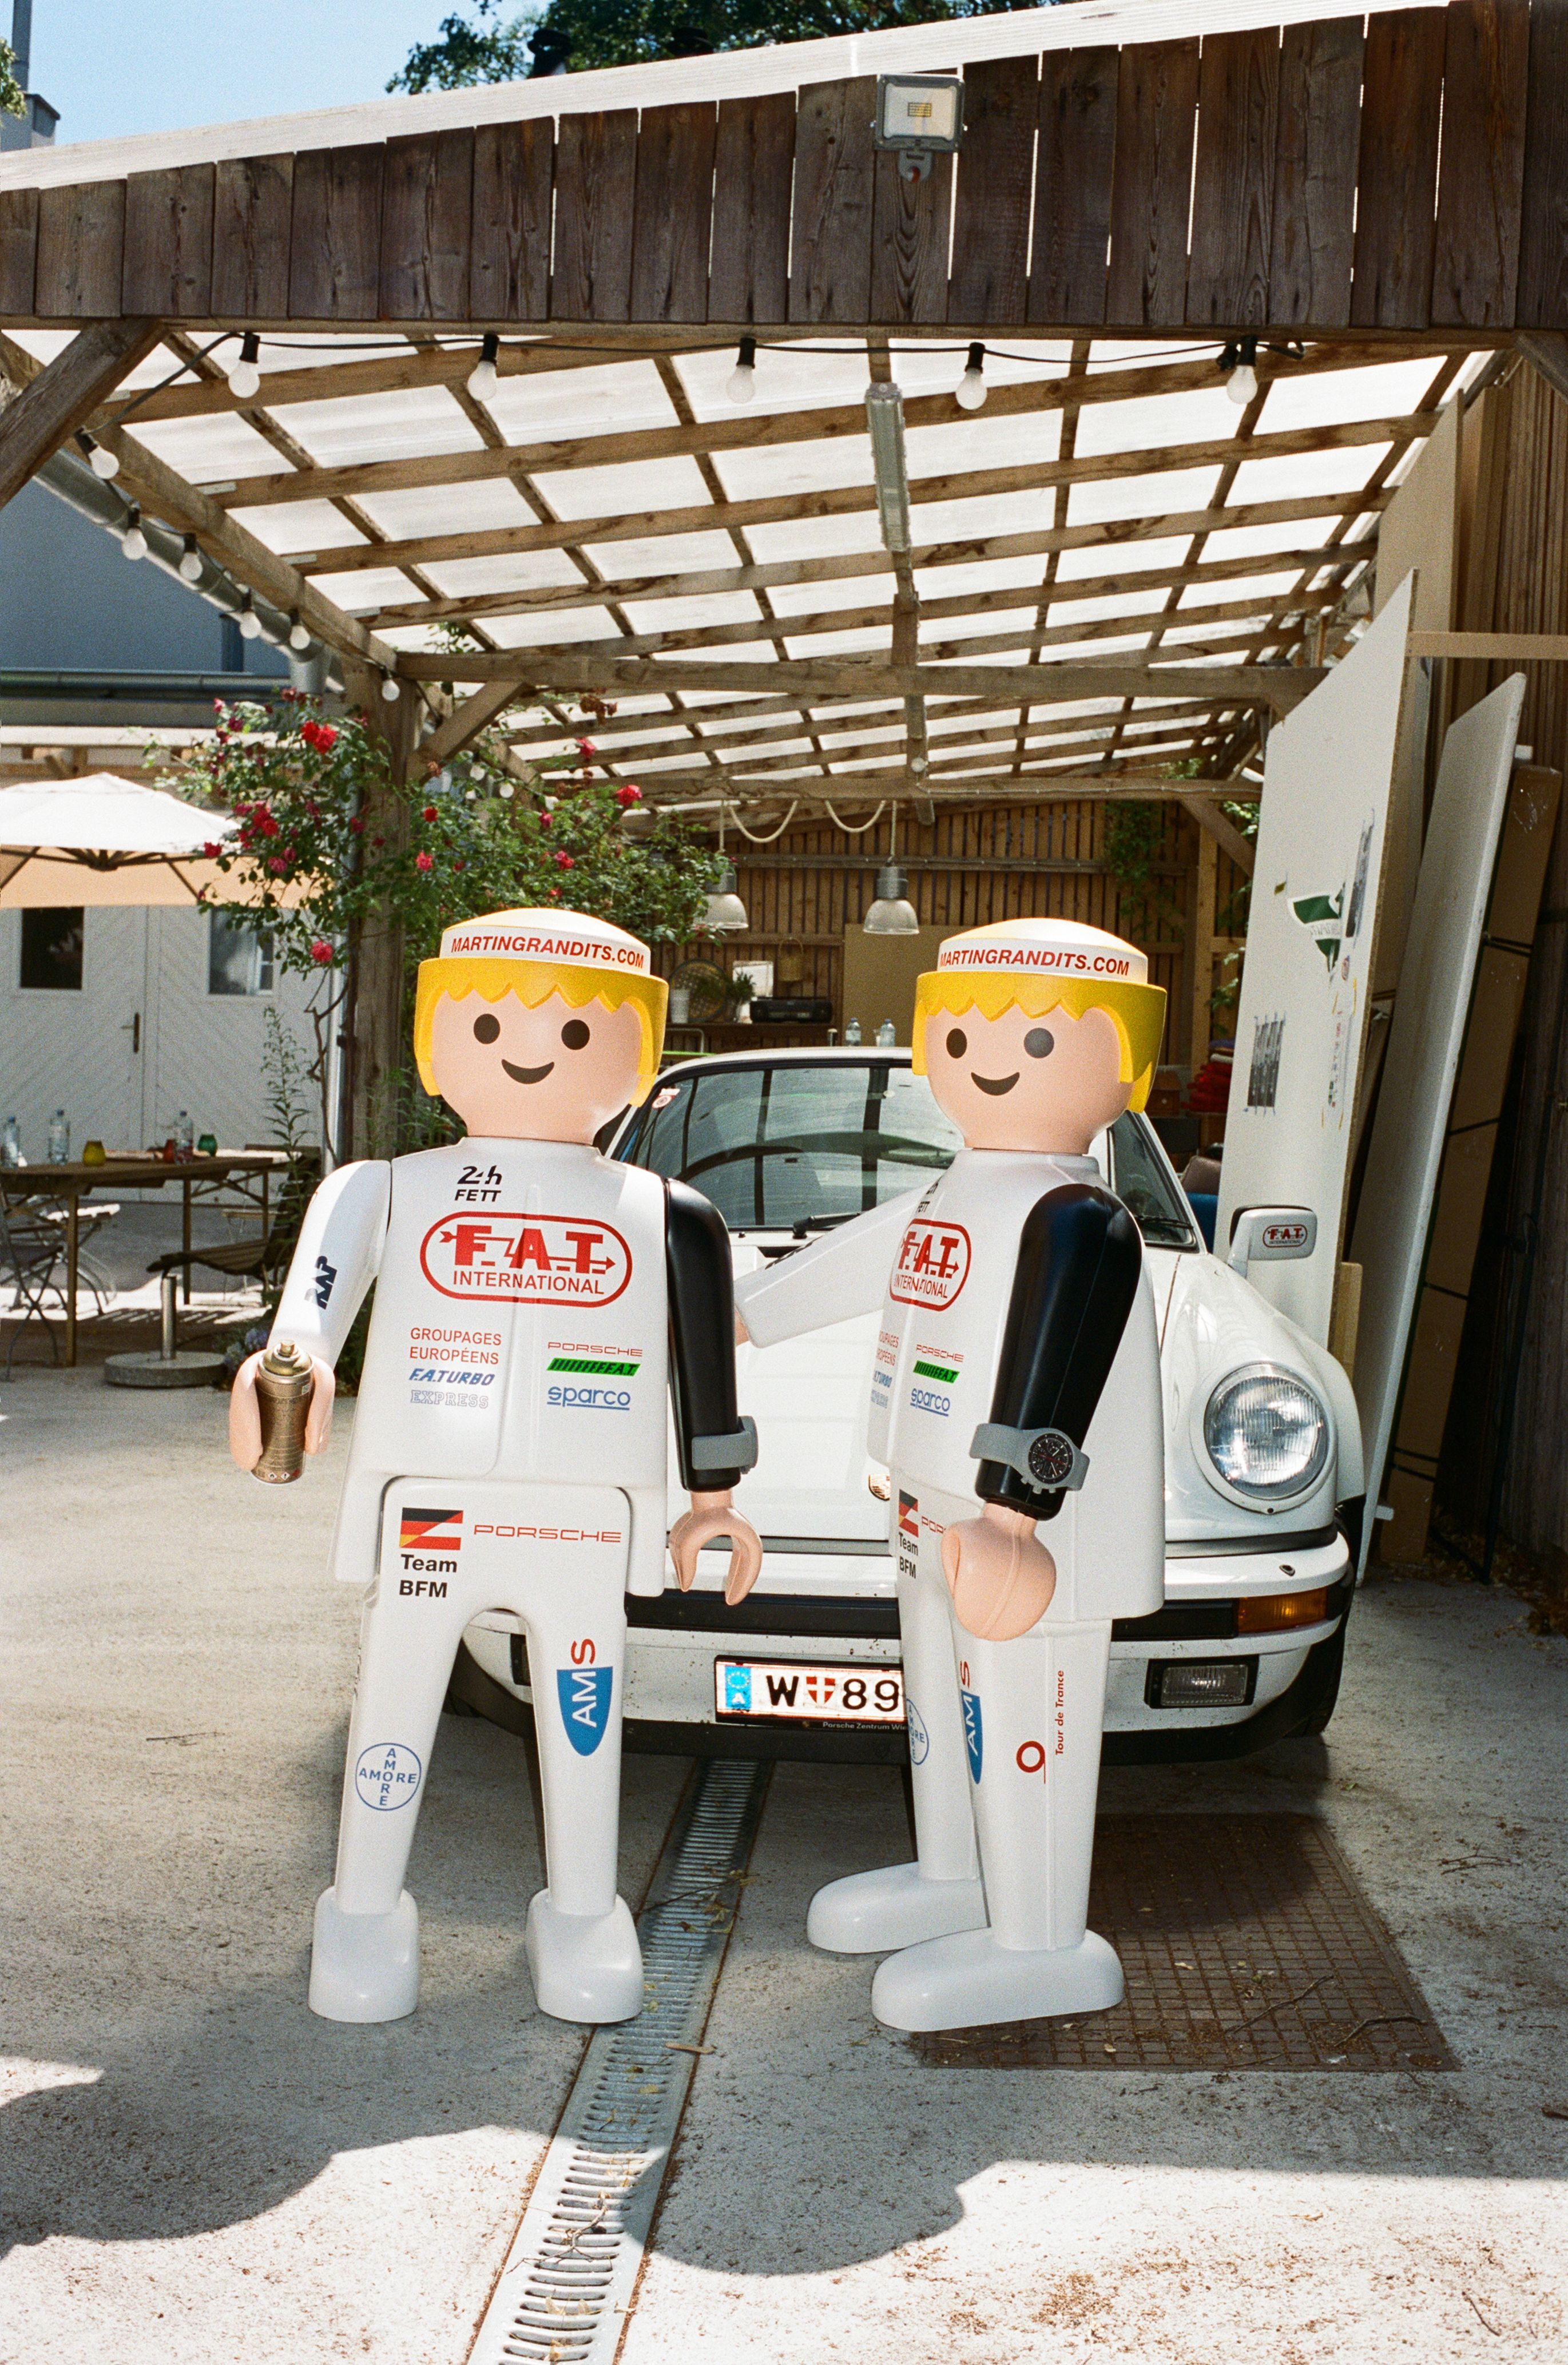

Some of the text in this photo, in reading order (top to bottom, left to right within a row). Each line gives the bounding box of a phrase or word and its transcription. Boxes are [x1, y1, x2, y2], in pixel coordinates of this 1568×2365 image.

[451, 935, 644, 969] MARTINGRANDITS.COM
[940, 949, 1130, 976] MARTINGRANDITS.COM
[457, 1165, 502, 1185] 24h
[454, 1189, 502, 1202] FETT
[453, 1271, 605, 1295] INTERNATIONAL
[410, 1327, 502, 1346] GROUPAGES
[410, 1346, 499, 1365] EUROPÉENS
[547, 1342, 643, 1357] PORSCHE
[916, 1344, 964, 1363] PORSCHE
[411, 1390, 489, 1409] EXPRESS
[547, 1386, 630, 1407] sparco
[911, 1388, 950, 1412] sparco
[474, 1525, 622, 1543] PORSCHE
[899, 1531, 918, 1556] Team
[400, 1554, 458, 1573] Team
[900, 1555, 916, 1579] BFM
[399, 1580, 448, 1598] BFM
[570, 1638, 597, 1728] AMS
[765, 1674, 900, 1712] W 89
[1055, 1670, 1065, 1755] Tour de Trance
[359, 1767, 417, 1784] AMORE
[379, 1748, 396, 1806] AMORE
